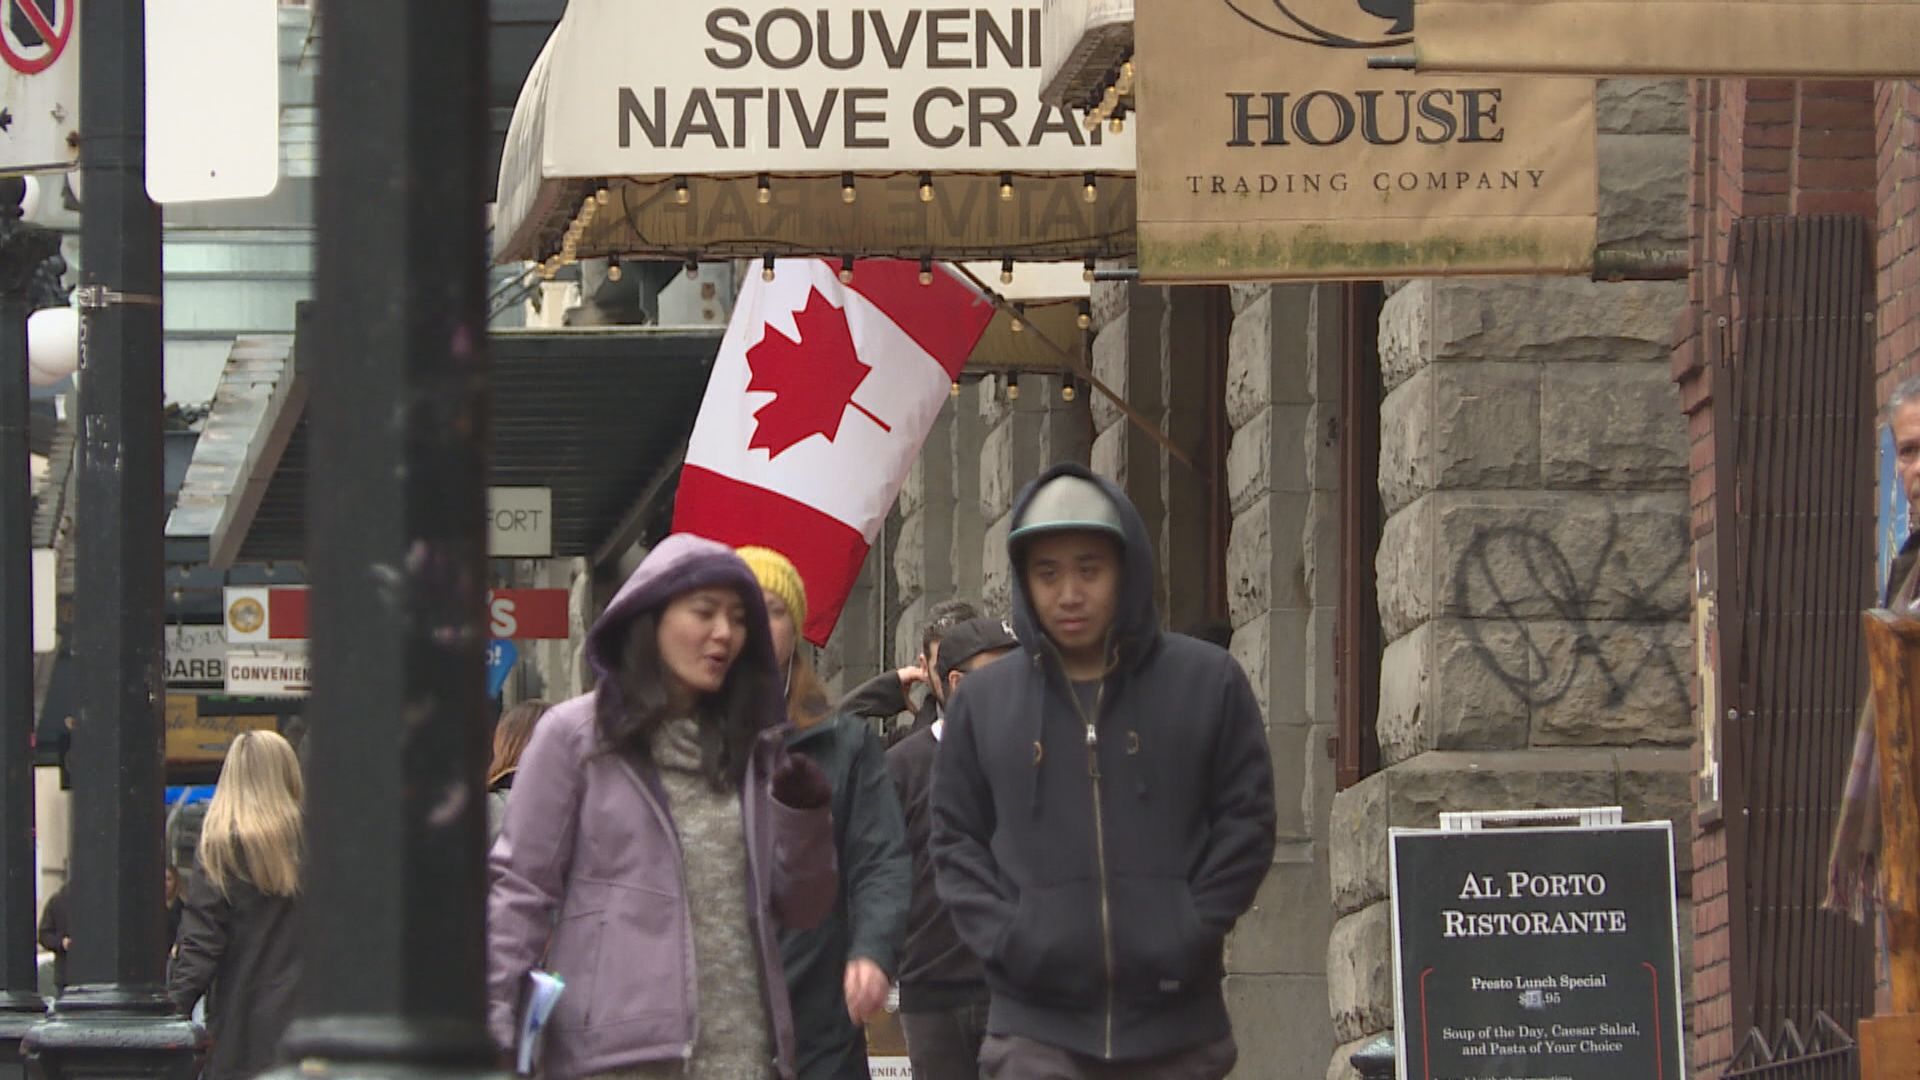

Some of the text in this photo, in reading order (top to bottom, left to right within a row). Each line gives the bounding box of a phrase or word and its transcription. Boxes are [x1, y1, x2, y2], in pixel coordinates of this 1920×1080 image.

[704, 7, 1042, 70] SOUVENI
[618, 87, 890, 149] NATIVE
[1225, 88, 1505, 147] HOUSE
[1186, 170, 1545, 194] TRADING COMPANY
[1459, 871, 1606, 899] AL PORTO
[1442, 910, 1627, 937] RISTORANTE
[1471, 974, 1606, 990] Presto Lunch Special
[1442, 1028, 1475, 1041] Soup
[1478, 1026, 1492, 1038] of
[1494, 1026, 1515, 1038] the
[1551, 1024, 1596, 1037] Caesar
[1462, 1040, 1623, 1056] and Pasta of Your Choice
